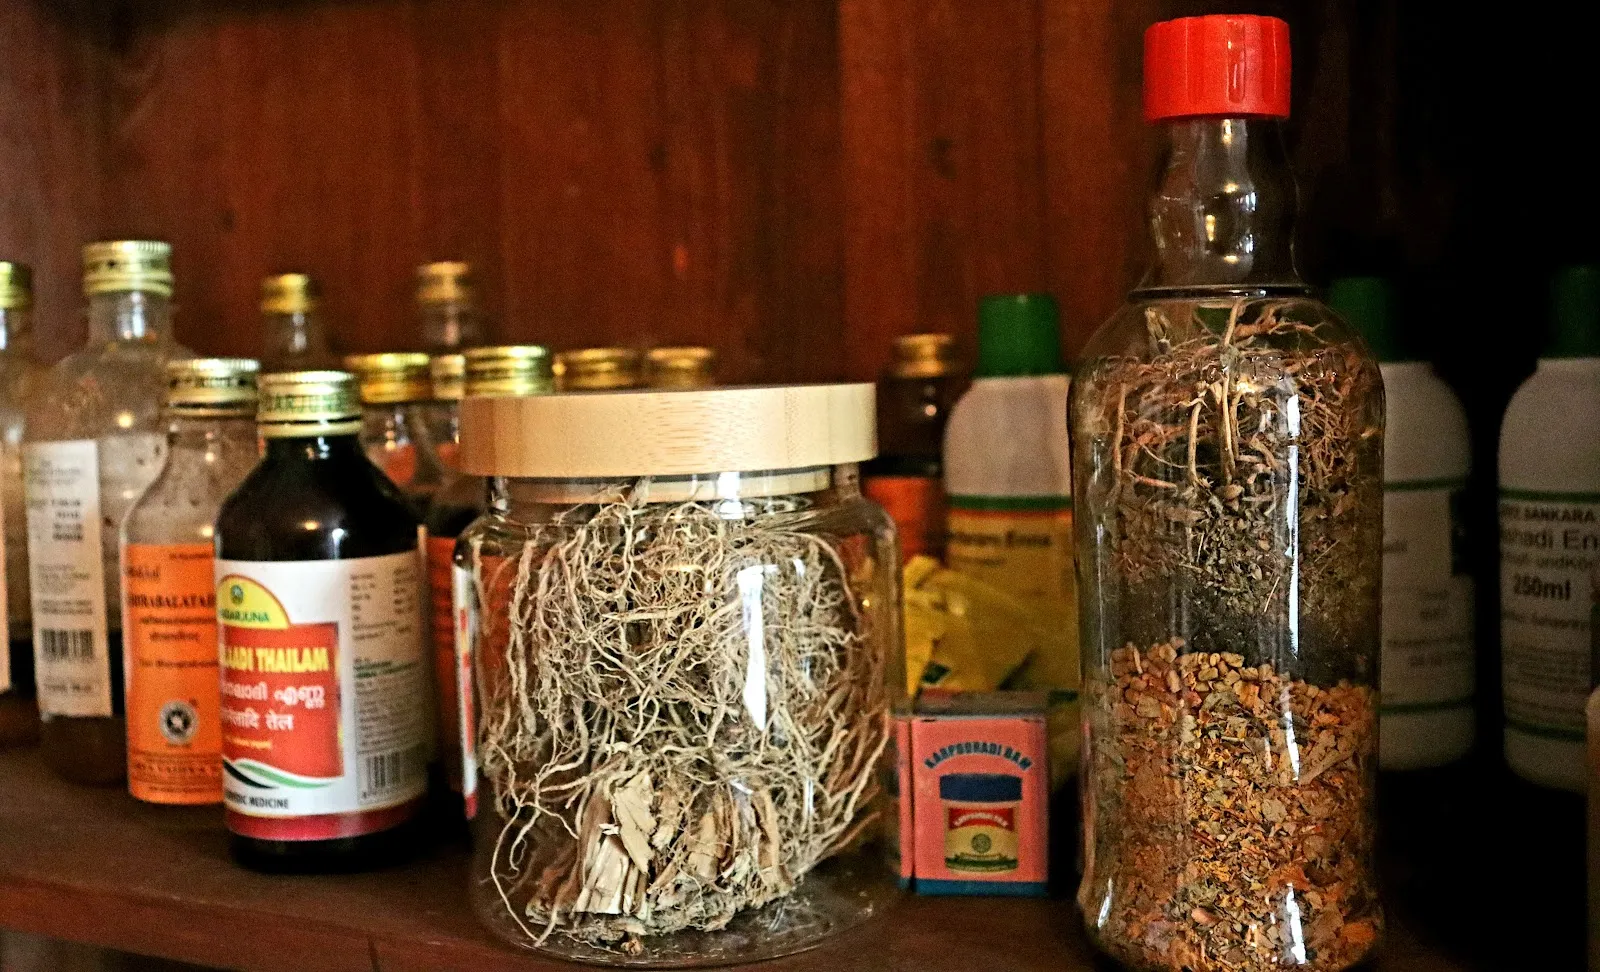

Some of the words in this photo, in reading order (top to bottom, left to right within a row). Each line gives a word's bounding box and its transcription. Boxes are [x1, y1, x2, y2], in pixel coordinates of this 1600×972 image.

[1512, 573, 1571, 600] 250ml
[255, 646, 329, 673] THAILAM
[249, 796, 289, 809] MEDICINE
